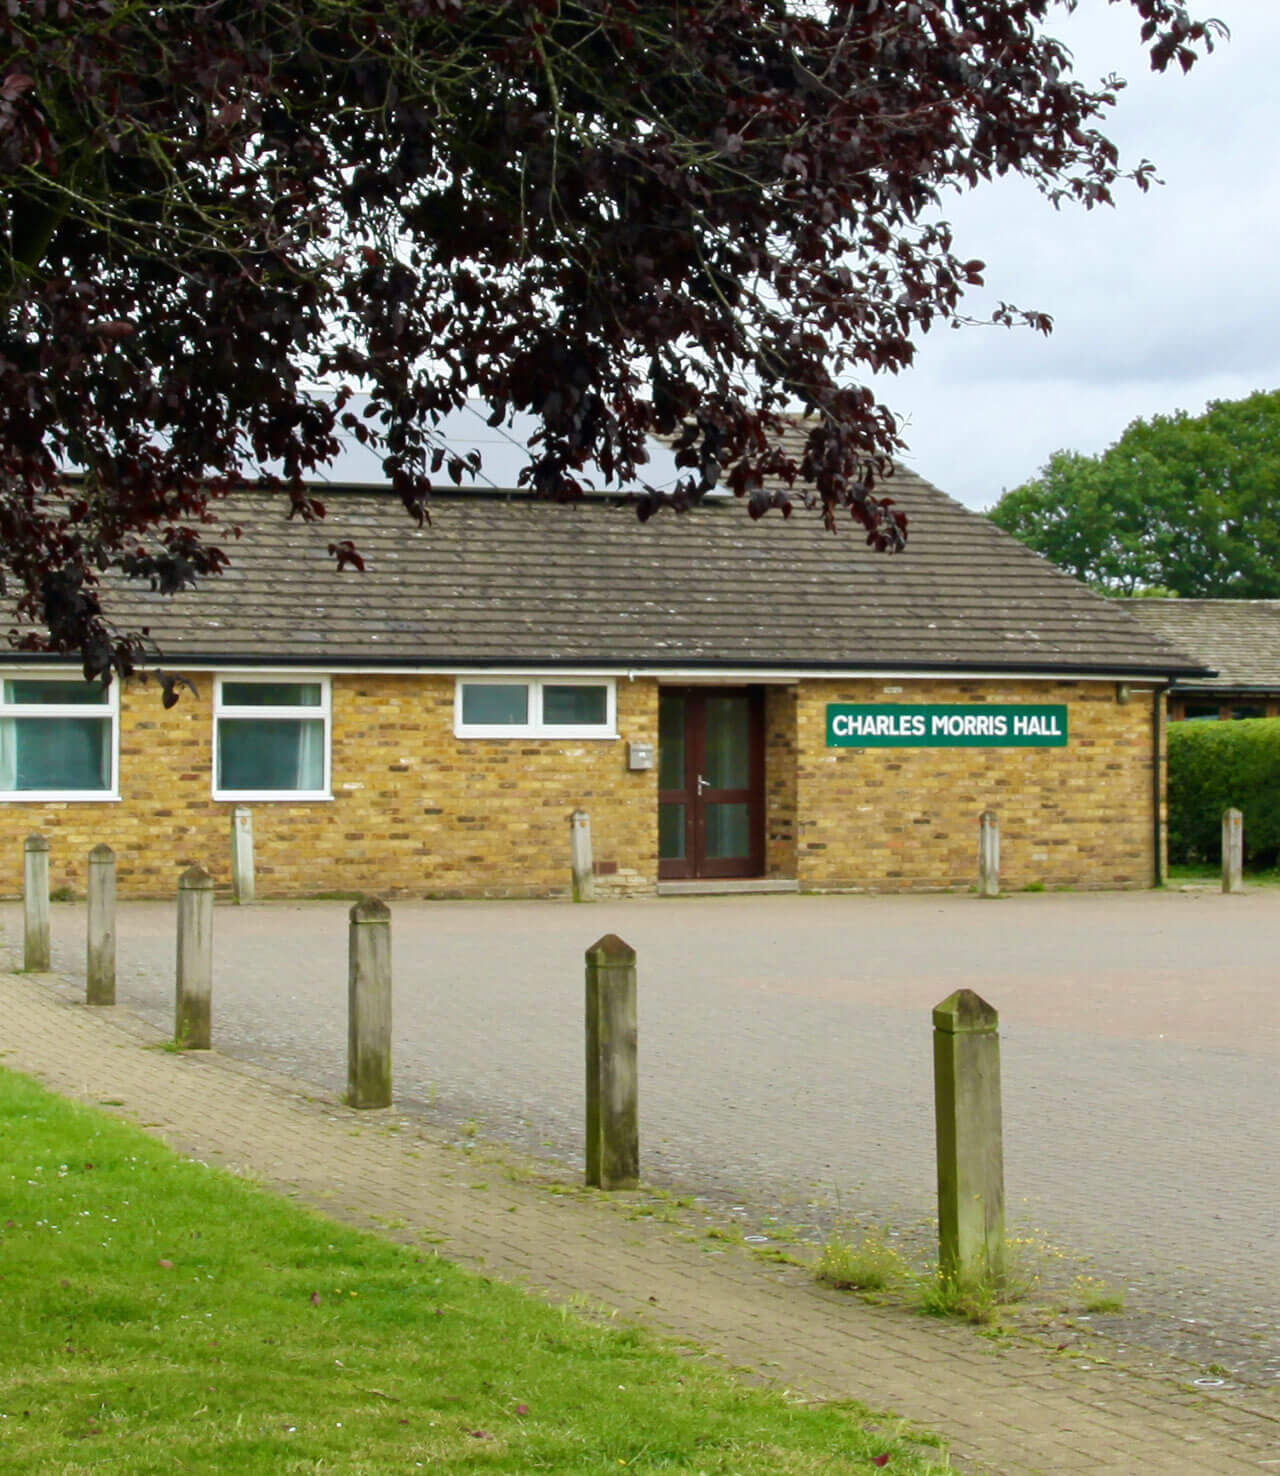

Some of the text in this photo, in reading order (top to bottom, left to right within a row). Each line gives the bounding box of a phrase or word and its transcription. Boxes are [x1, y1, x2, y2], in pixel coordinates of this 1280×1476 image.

[832, 715, 1061, 736] CHARLES MORRIS HALL
